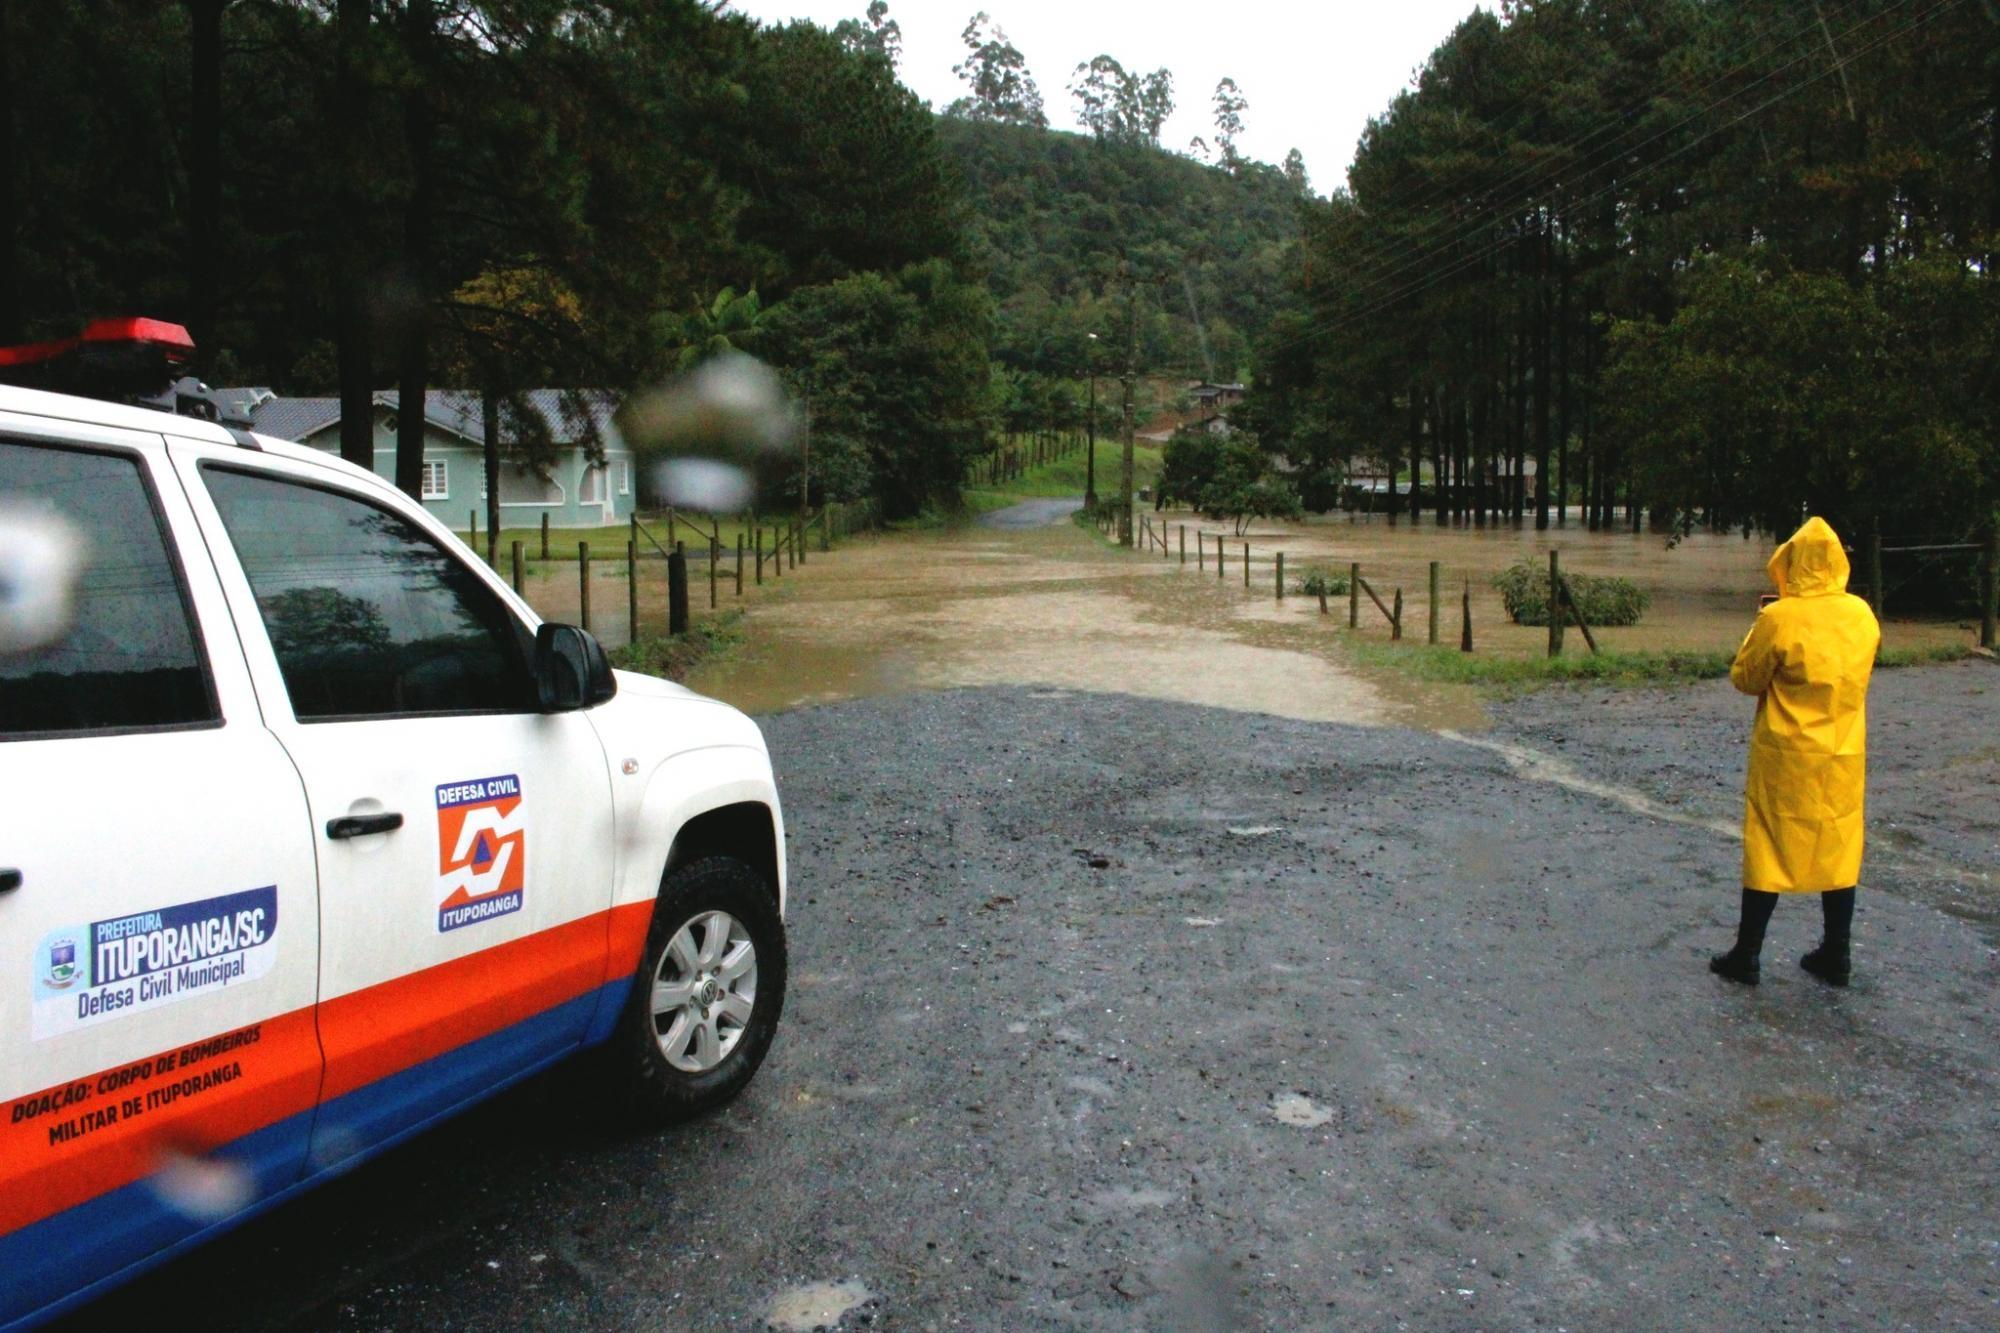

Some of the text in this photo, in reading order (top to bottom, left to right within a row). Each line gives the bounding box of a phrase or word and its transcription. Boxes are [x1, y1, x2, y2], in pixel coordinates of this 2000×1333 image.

[438, 779, 518, 804] DEFESA CIVIL
[97, 912, 163, 942] PREFEITURA
[443, 894, 519, 928] ITUPORANGA
[97, 907, 266, 983] ITUPORANGA/SC
[78, 953, 245, 1019] Defesa Civil Municipal
[11, 1025, 262, 1124] DOAÇÃO: CORPO DE BOMBEIROS
[49, 1062, 242, 1146] MILITAR DE ITUPORANGA
